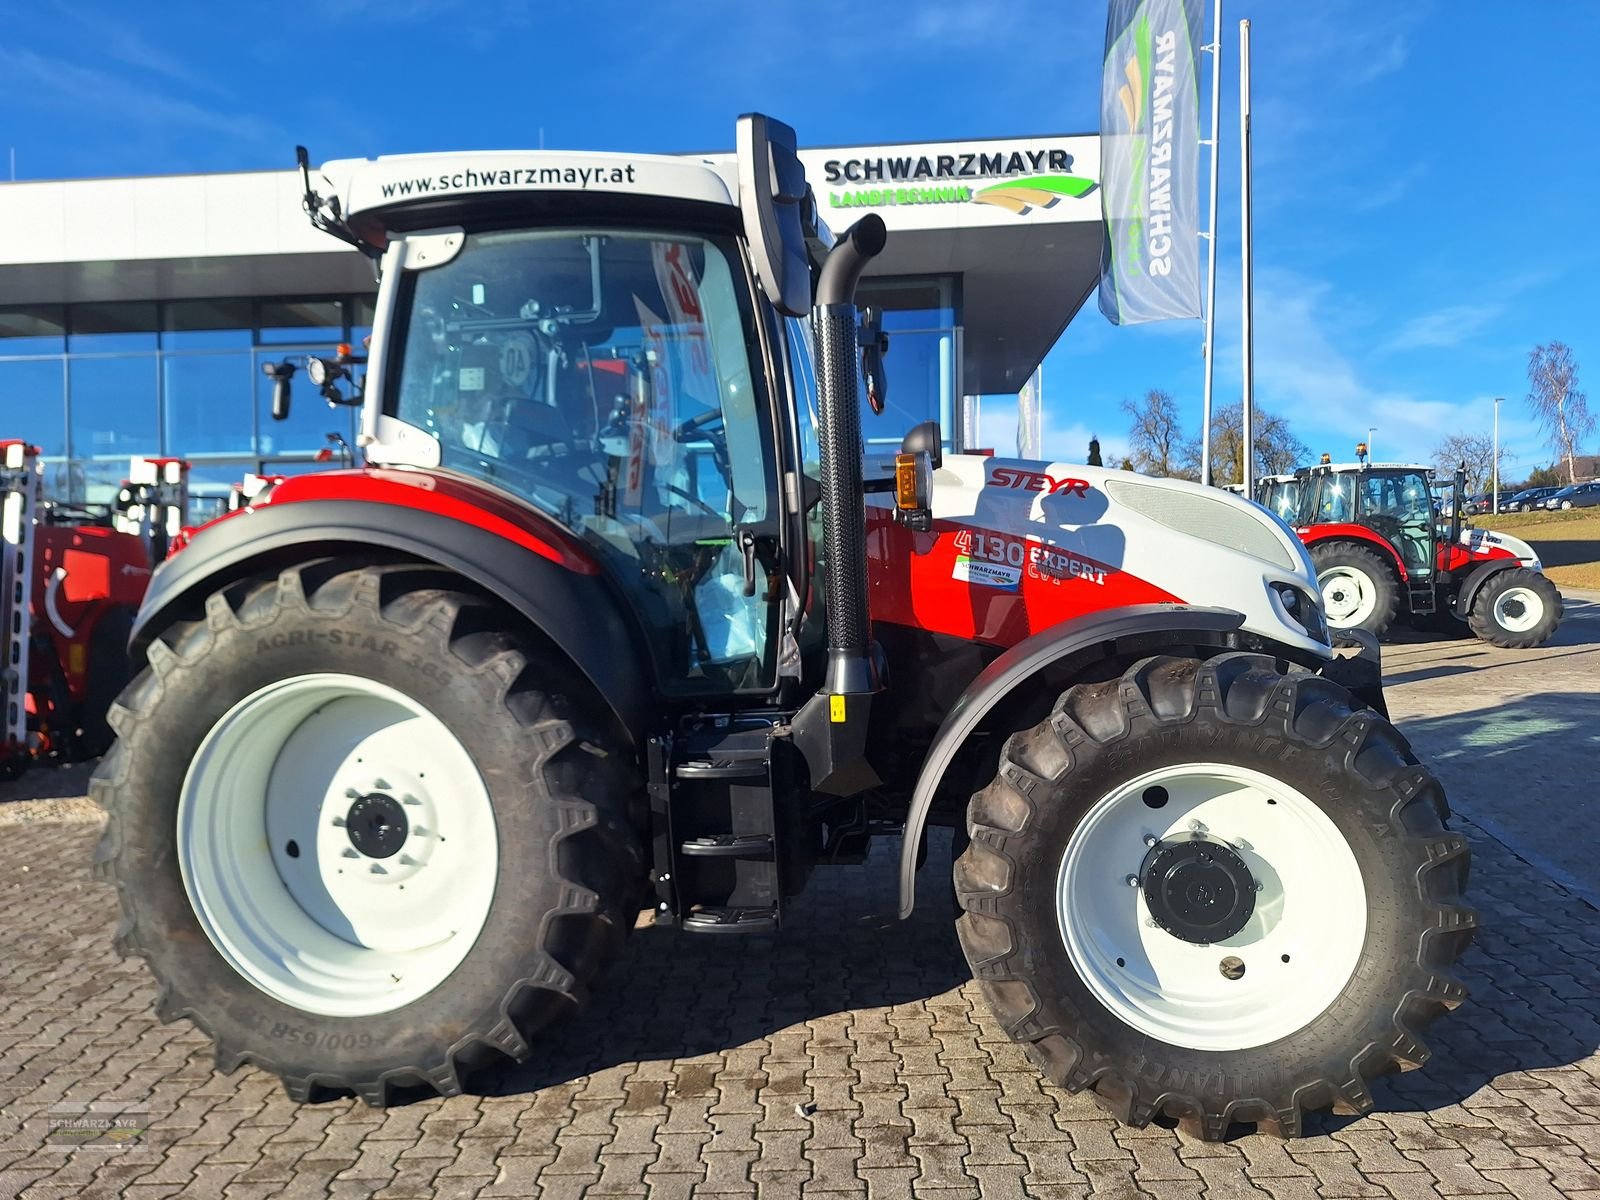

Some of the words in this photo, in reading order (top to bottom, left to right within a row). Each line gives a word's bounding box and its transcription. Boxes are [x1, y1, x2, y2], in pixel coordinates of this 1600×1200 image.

[381, 163, 636, 199] www.schwarzmayr.at
[823, 148, 1071, 184] SCHWARZMAYR
[829, 185, 972, 209] LANDTECHNIK
[987, 468, 1090, 499] STEYR
[953, 529, 1025, 567] 4130
[1029, 546, 1108, 586] EXPERT
[1027, 562, 1063, 586] CVT
[256, 628, 400, 657] AGRI-STAR
